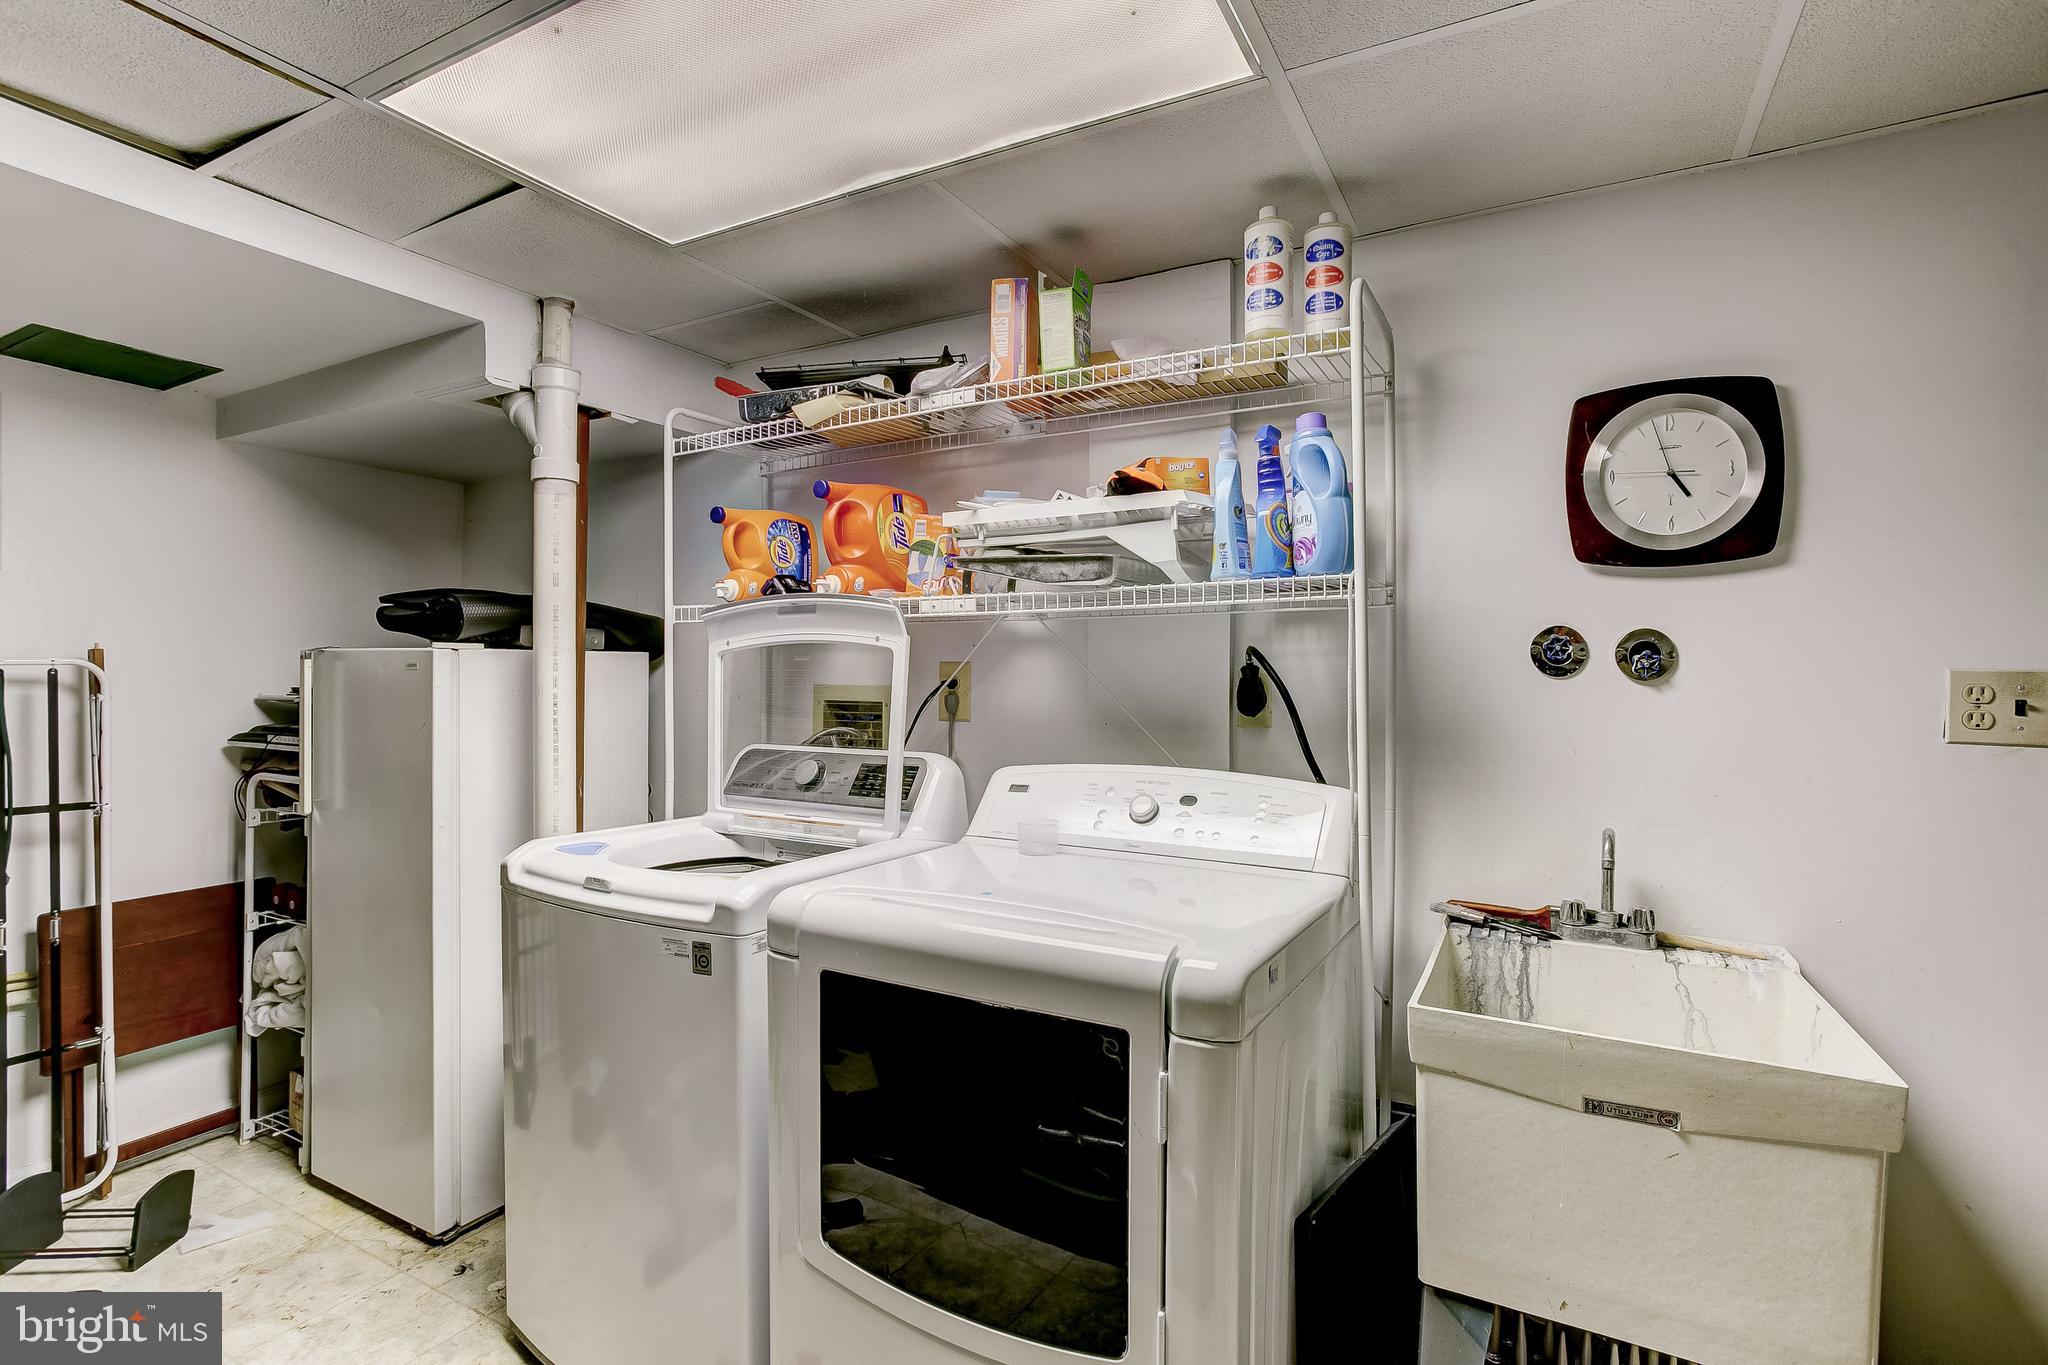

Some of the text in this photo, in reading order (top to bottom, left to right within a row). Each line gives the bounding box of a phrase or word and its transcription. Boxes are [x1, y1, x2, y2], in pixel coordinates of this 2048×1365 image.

[1665, 414, 1676, 432] 12
[1729, 459, 1735, 477] 3
[1609, 470, 1616, 485] 9
[1668, 515, 1675, 532] 6
[892, 516, 911, 550] Tide
[777, 539, 791, 564] Tide
